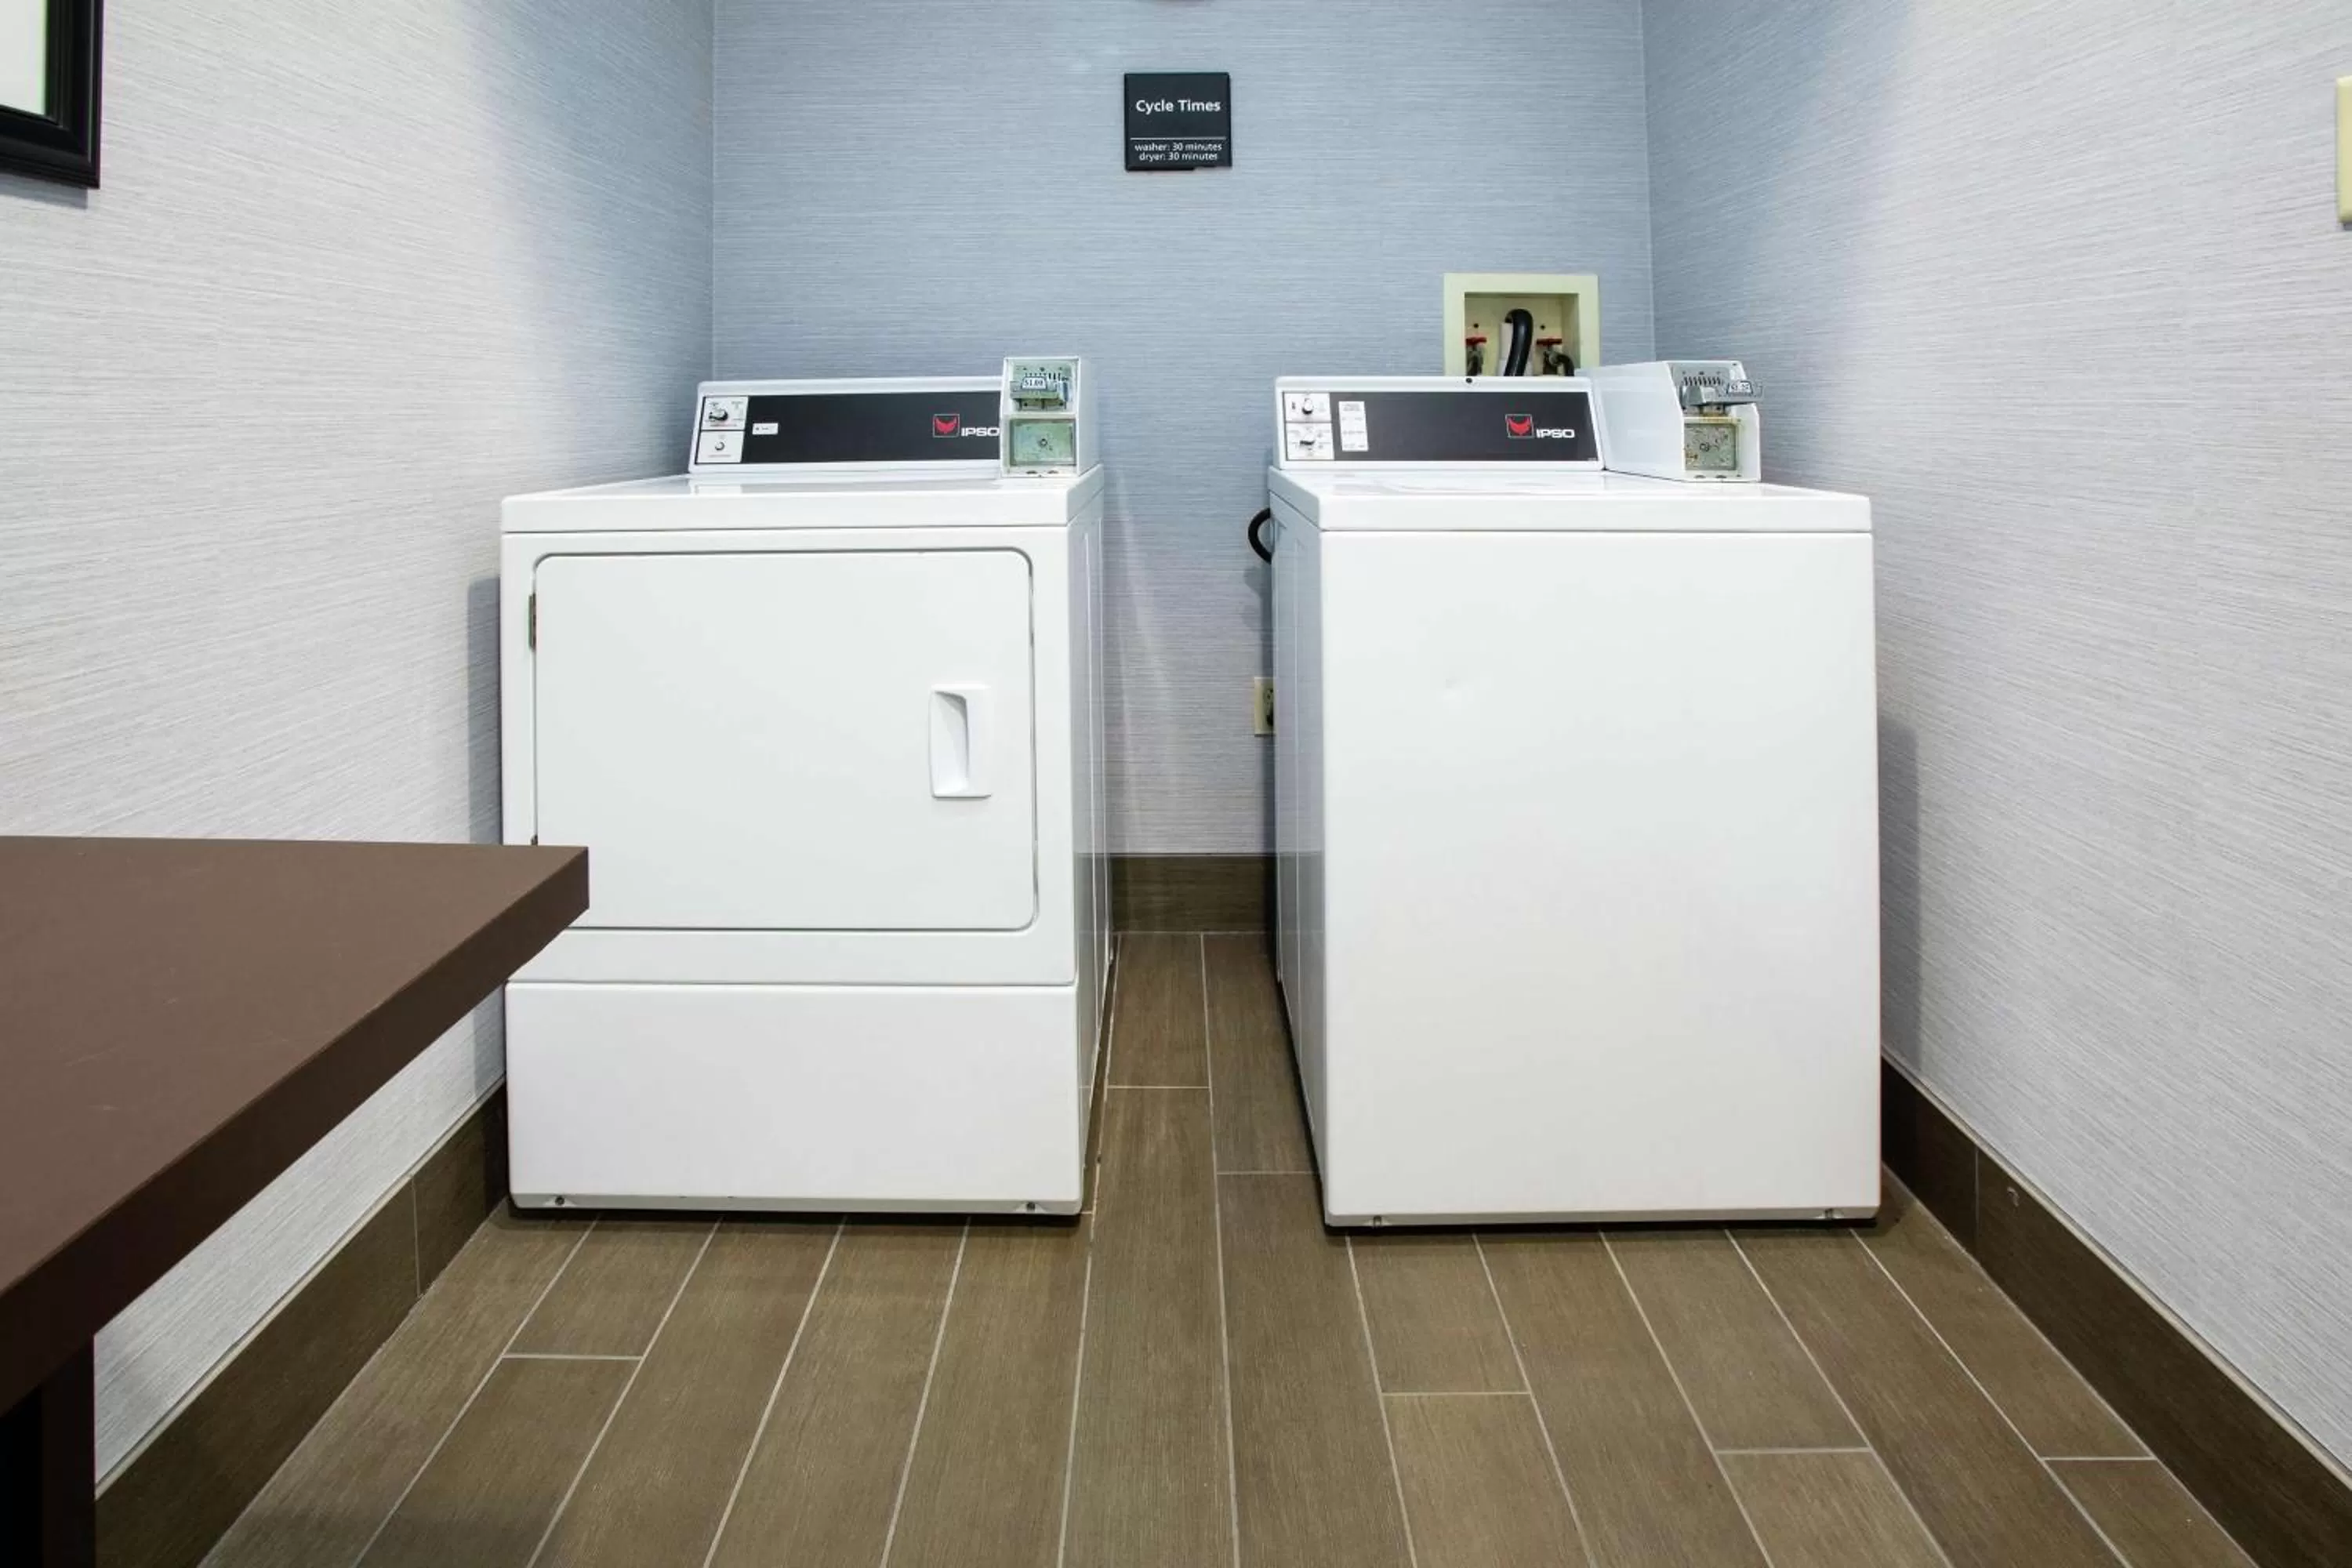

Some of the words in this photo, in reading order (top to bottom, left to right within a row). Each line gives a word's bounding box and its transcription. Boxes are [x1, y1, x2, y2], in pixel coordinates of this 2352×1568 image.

[1135, 99, 1174, 115] Cycle
[1177, 99, 1221, 112] Times
[1173, 142, 1183, 151] 30
[1185, 142, 1222, 151] minutes
[1168, 152, 1180, 161] 30
[1181, 152, 1218, 161] minutes
[960, 426, 1000, 437] IPSO
[1536, 428, 1575, 438] IPSO
